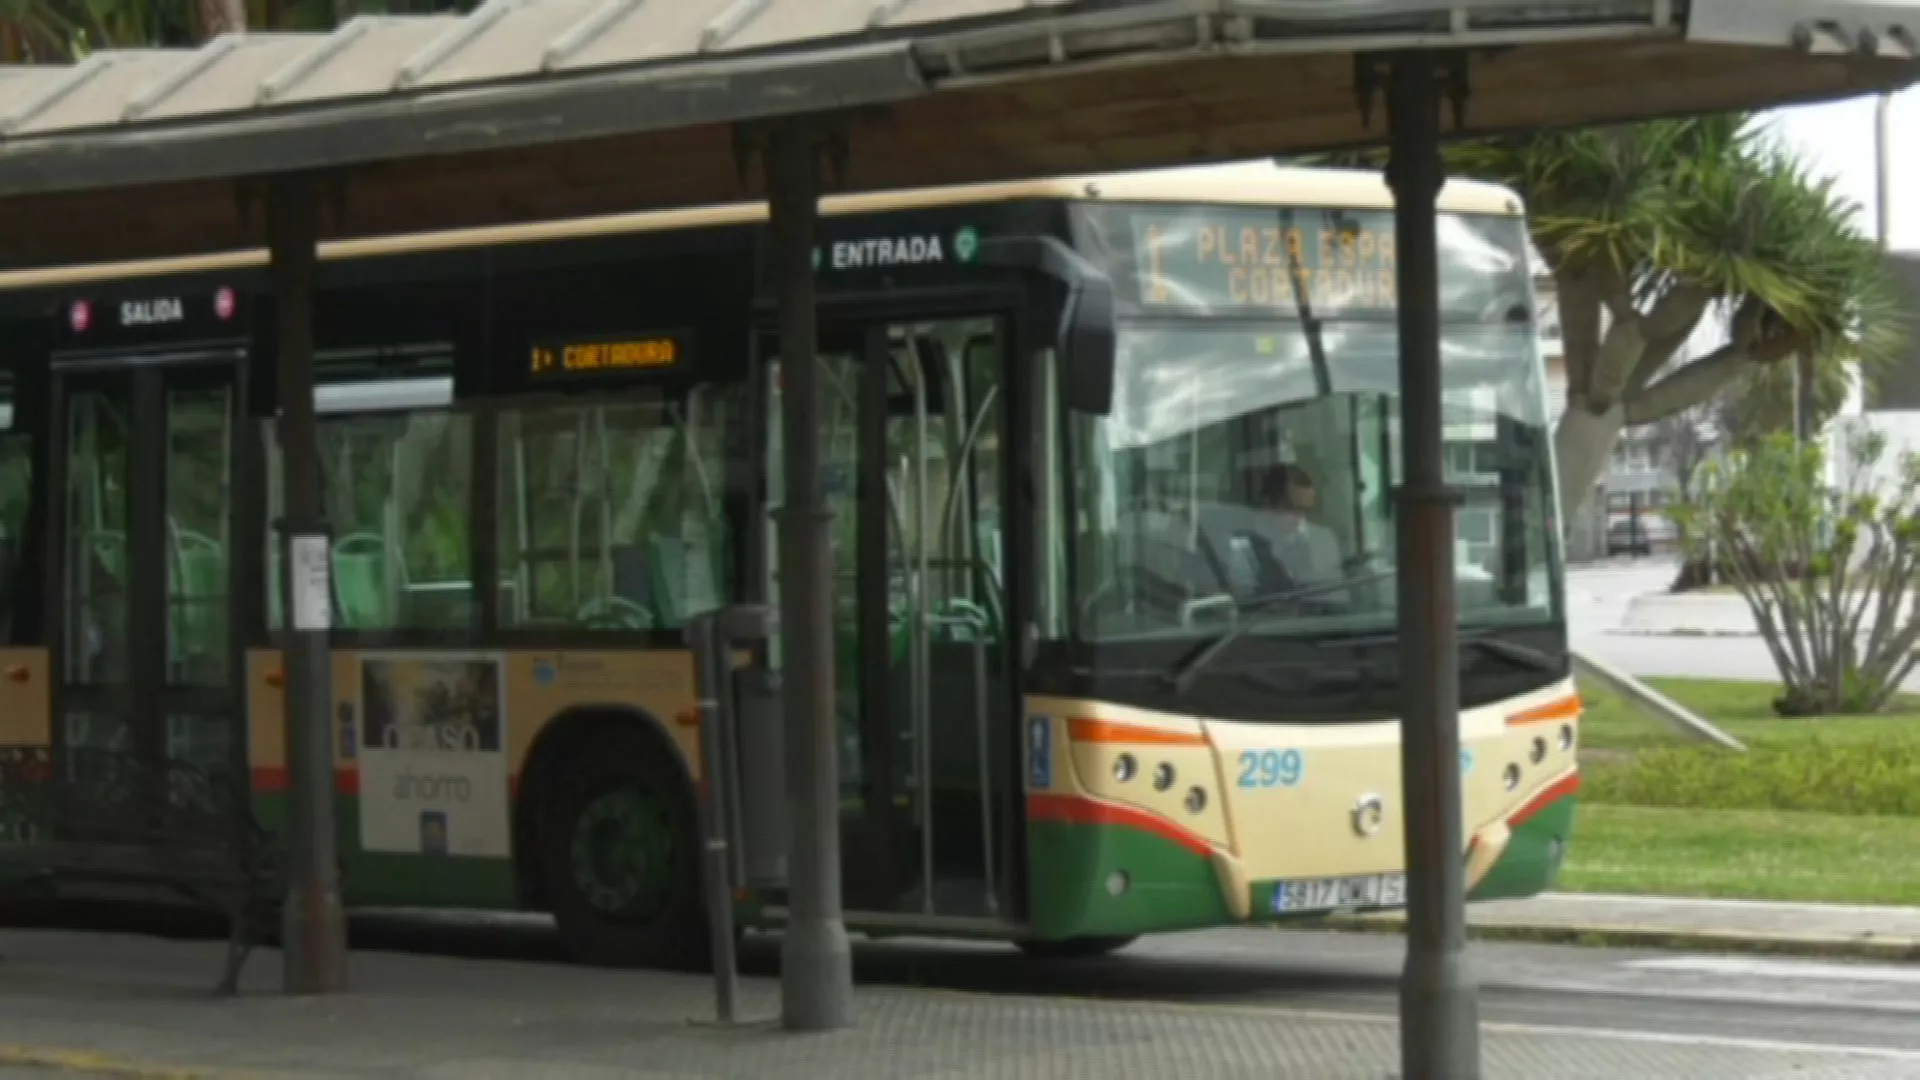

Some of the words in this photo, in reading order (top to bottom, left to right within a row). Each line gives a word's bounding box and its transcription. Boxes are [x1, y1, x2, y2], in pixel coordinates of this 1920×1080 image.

[831, 236, 943, 269] ENTRADA
[1197, 224, 1306, 268] PLAZA
[121, 299, 182, 325] SALIDA
[392, 763, 472, 803] ahorro
[1237, 748, 1302, 788] 299
